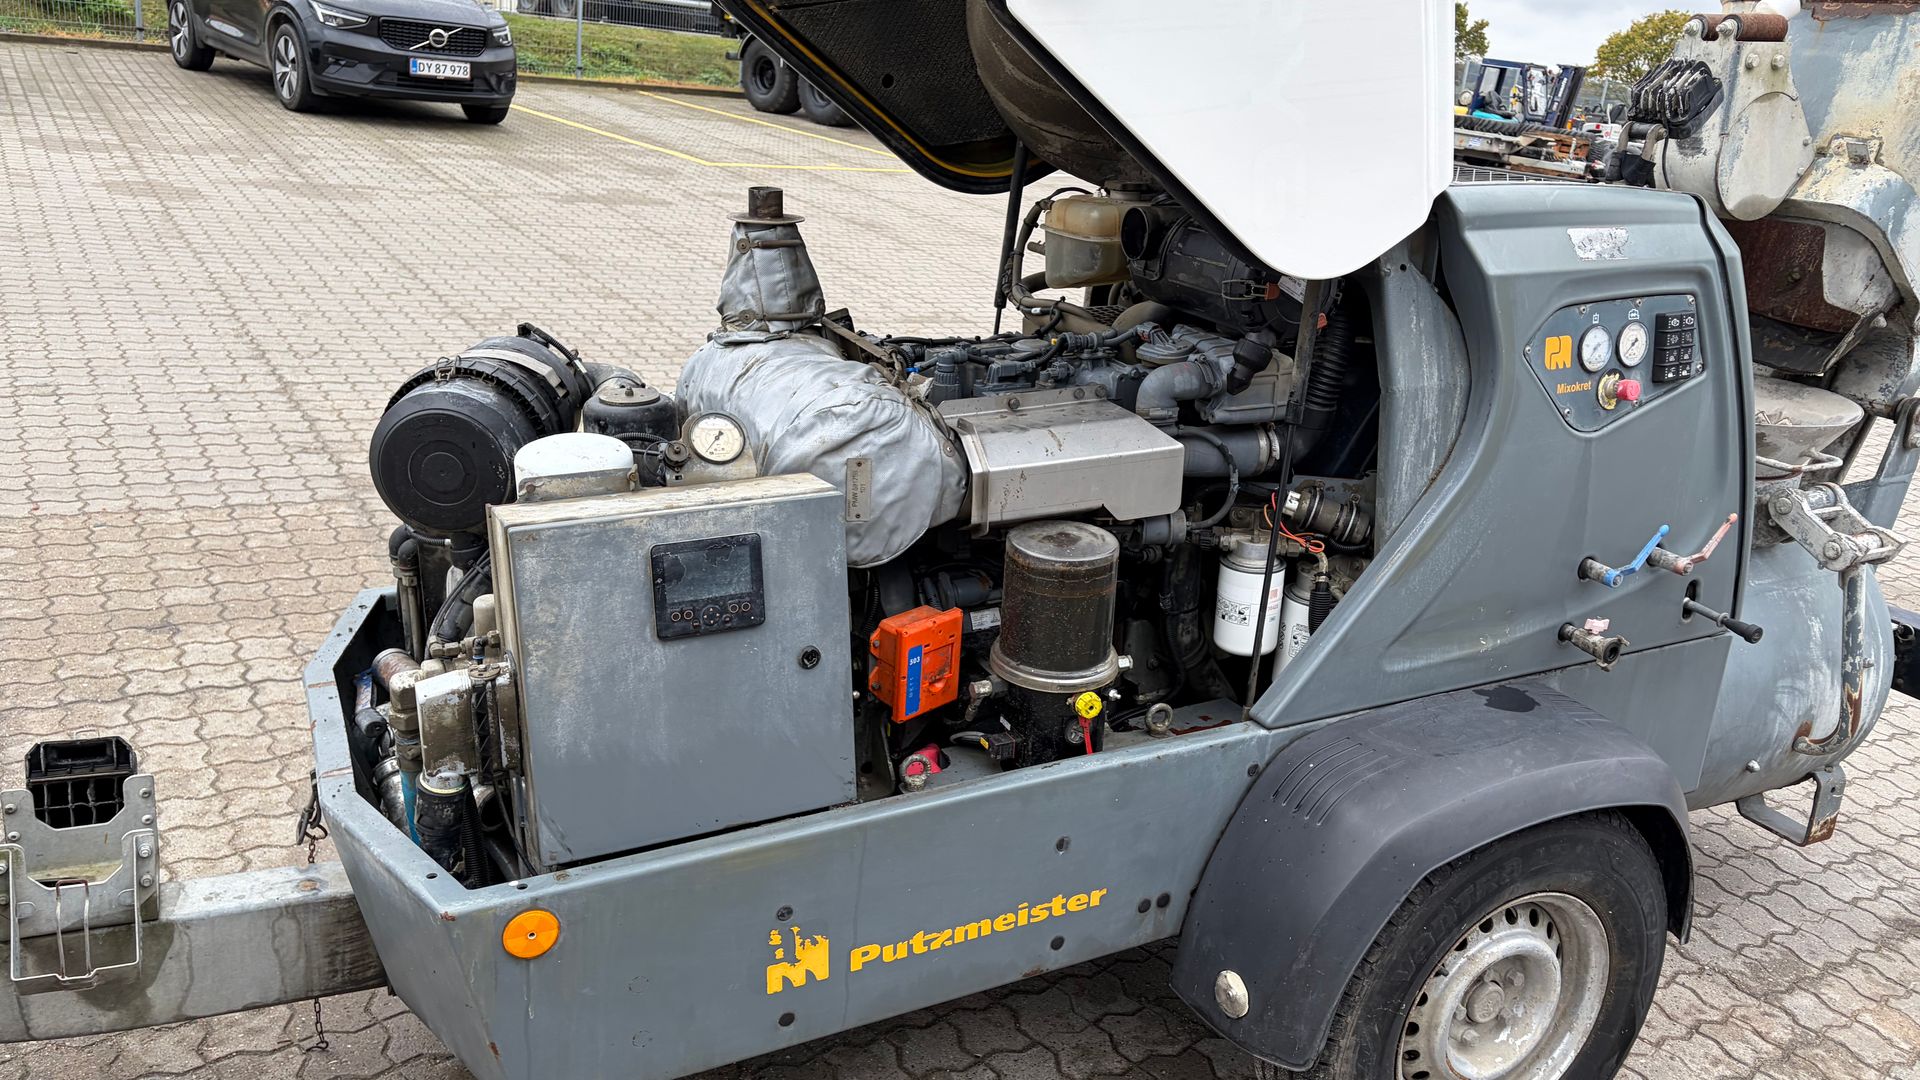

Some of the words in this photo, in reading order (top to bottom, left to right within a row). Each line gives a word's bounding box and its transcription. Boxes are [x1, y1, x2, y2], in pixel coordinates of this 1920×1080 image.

[418, 62, 432, 73] DY
[434, 63, 448, 74] 87
[450, 65, 469, 76] 978
[1556, 380, 1592, 394] Mixokret
[850, 887, 1107, 972] Putzmeister
